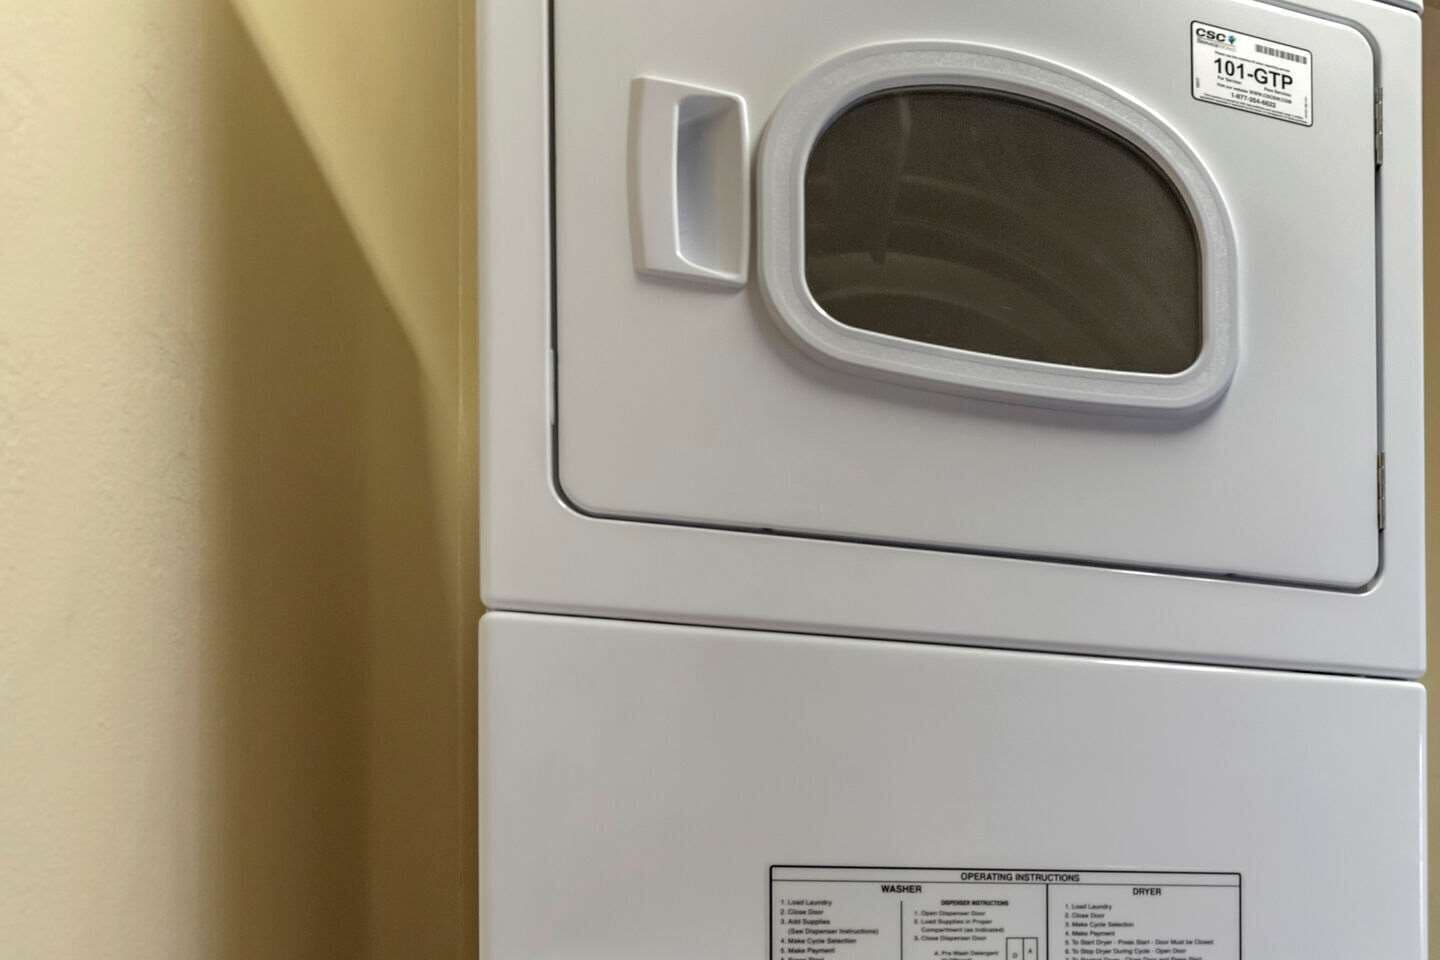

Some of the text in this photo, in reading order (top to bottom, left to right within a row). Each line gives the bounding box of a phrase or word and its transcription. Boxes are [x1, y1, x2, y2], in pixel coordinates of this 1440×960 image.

[1195, 28, 1226, 42] CSC
[1214, 58, 1293, 90] 101-GTP
[960, 872, 1080, 882] OPERATING INSTRUCTIONS
[881, 884, 922, 893] WASHER
[1132, 887, 1162, 896] DRYER
